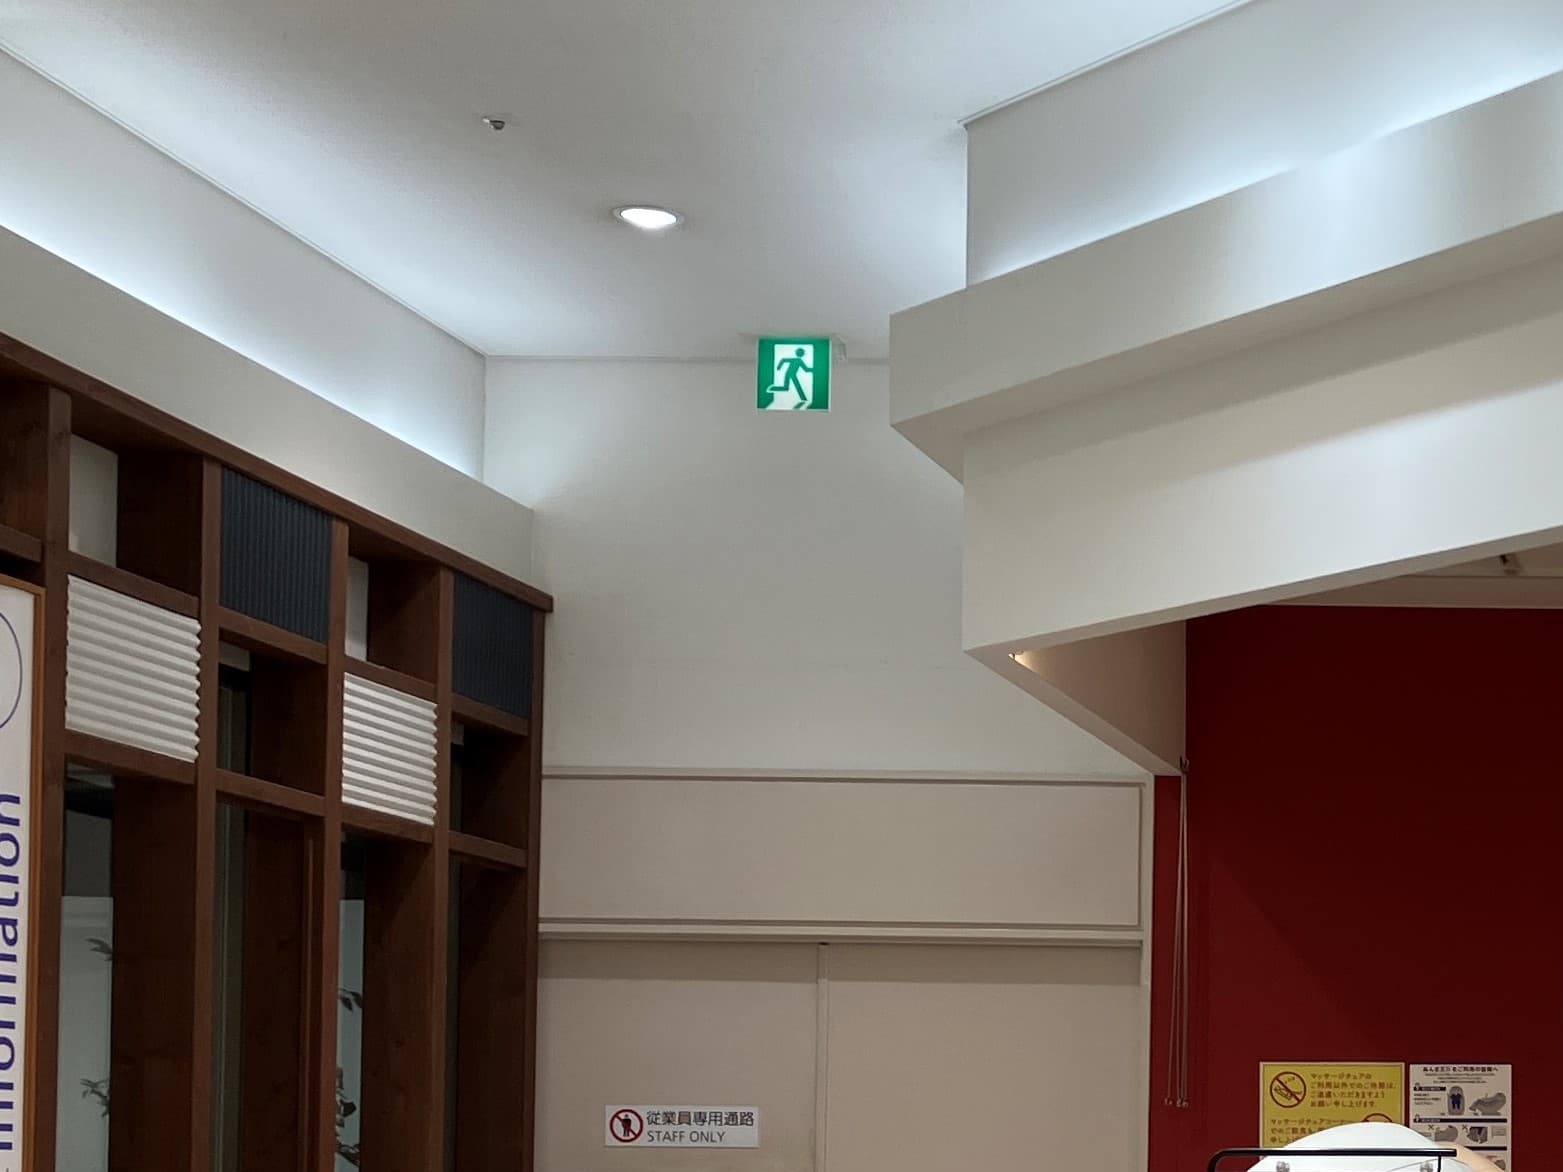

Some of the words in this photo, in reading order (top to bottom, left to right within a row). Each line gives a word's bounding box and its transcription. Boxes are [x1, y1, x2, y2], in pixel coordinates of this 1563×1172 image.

[647, 1111, 754, 1127] 従業員専用通路
[647, 1131, 685, 1143] STAFF
[689, 1131, 726, 1143] ONLY
